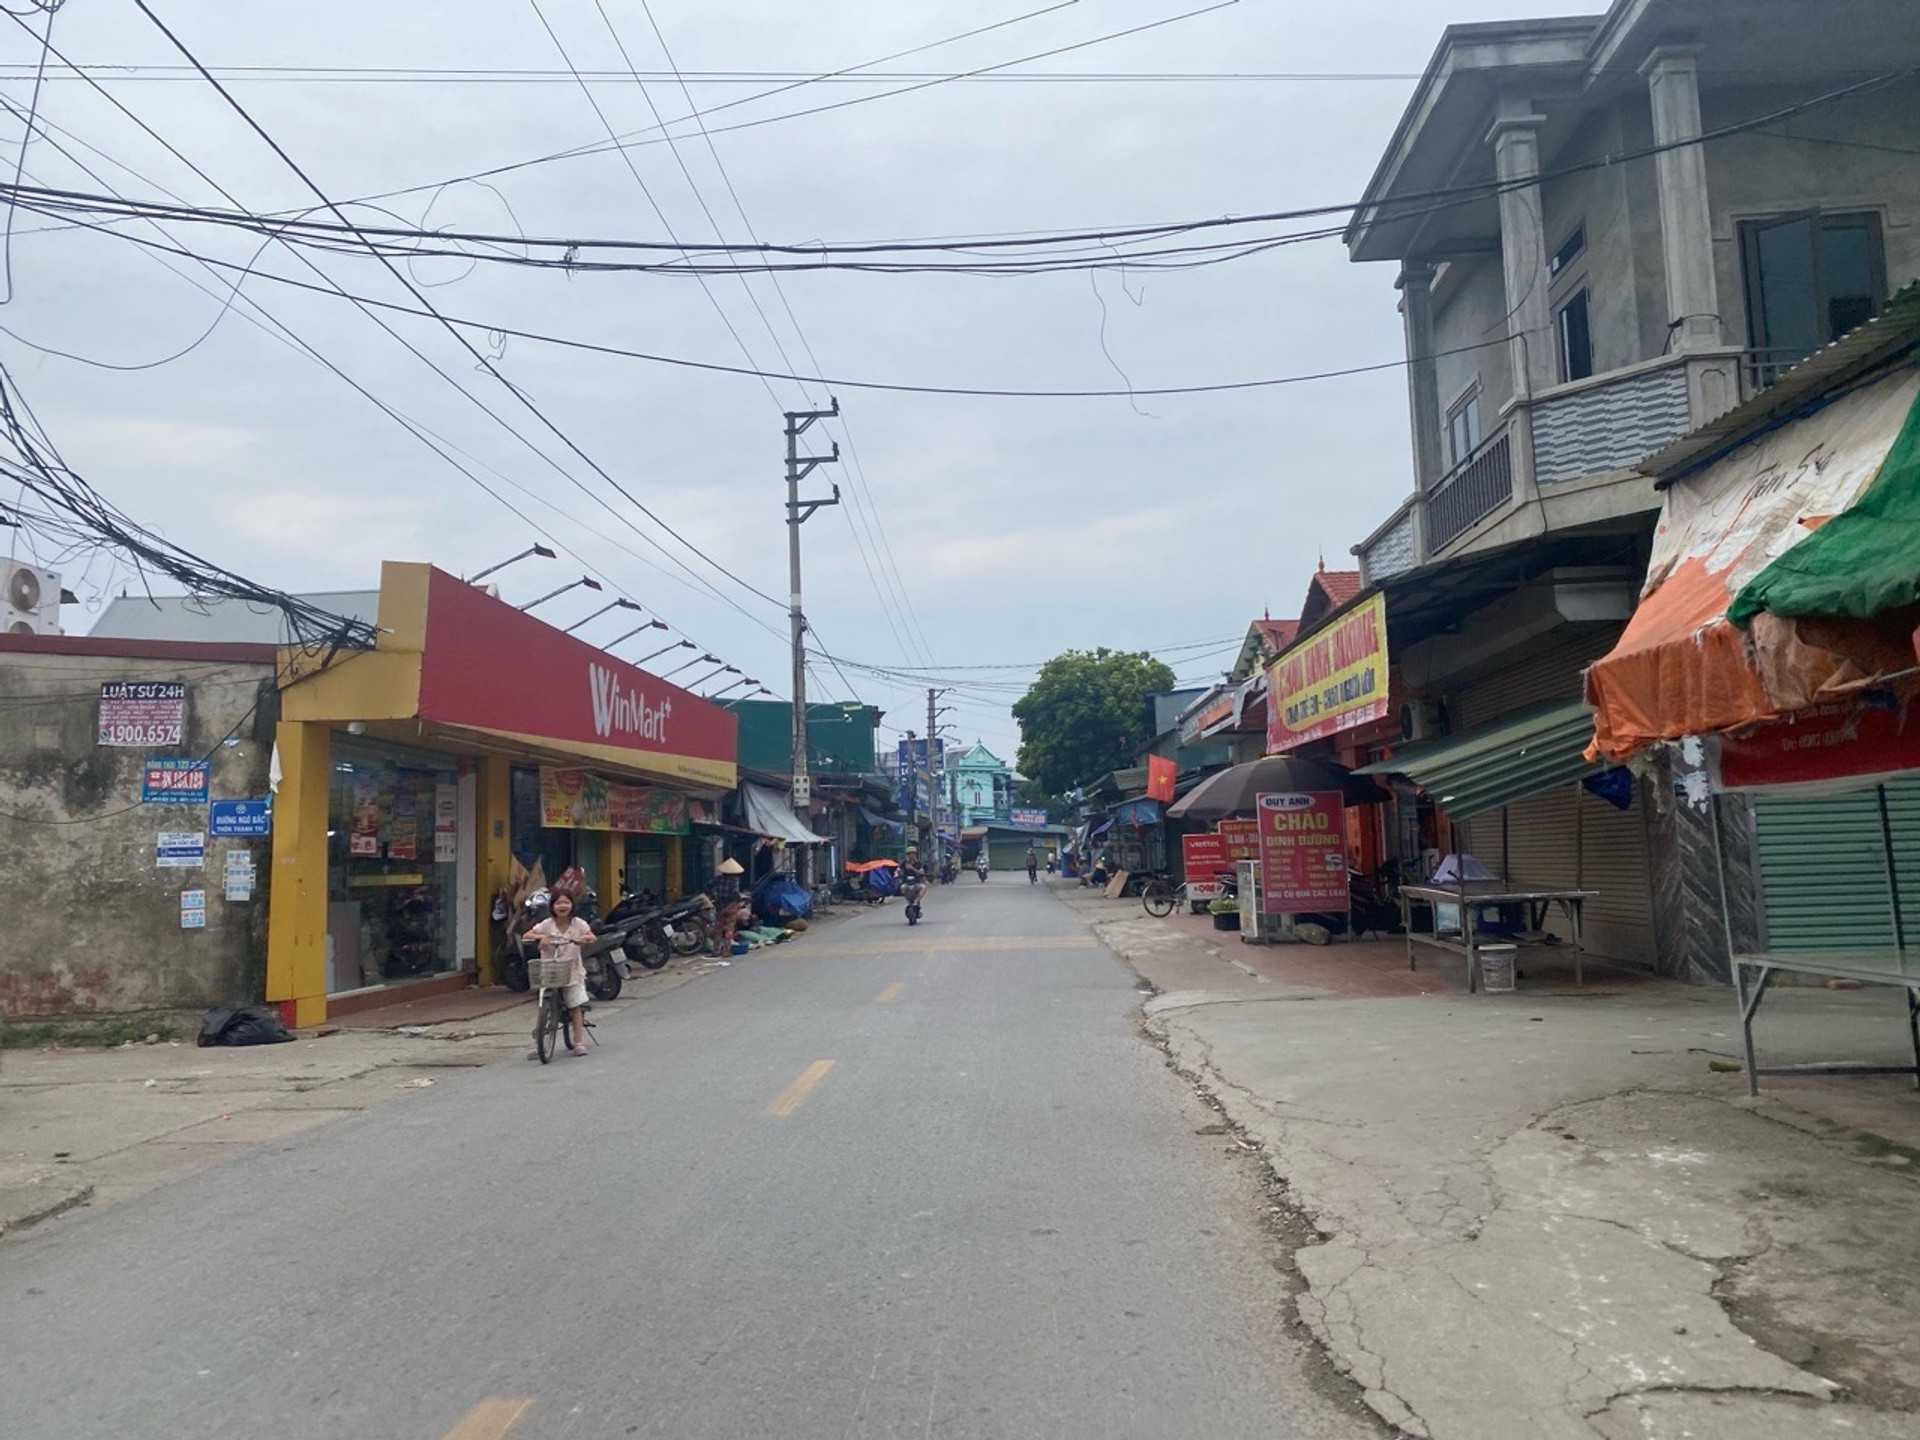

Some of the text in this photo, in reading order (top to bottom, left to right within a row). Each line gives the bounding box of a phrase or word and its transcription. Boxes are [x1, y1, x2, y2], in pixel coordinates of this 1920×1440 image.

[102, 682, 185, 700] LUẬT SƯ 24H
[108, 725, 181, 743] 1900.6574
[1288, 798, 1310, 806] ANH
[1273, 809, 1329, 831] CHÁO
[1266, 836, 1295, 847] DINH
